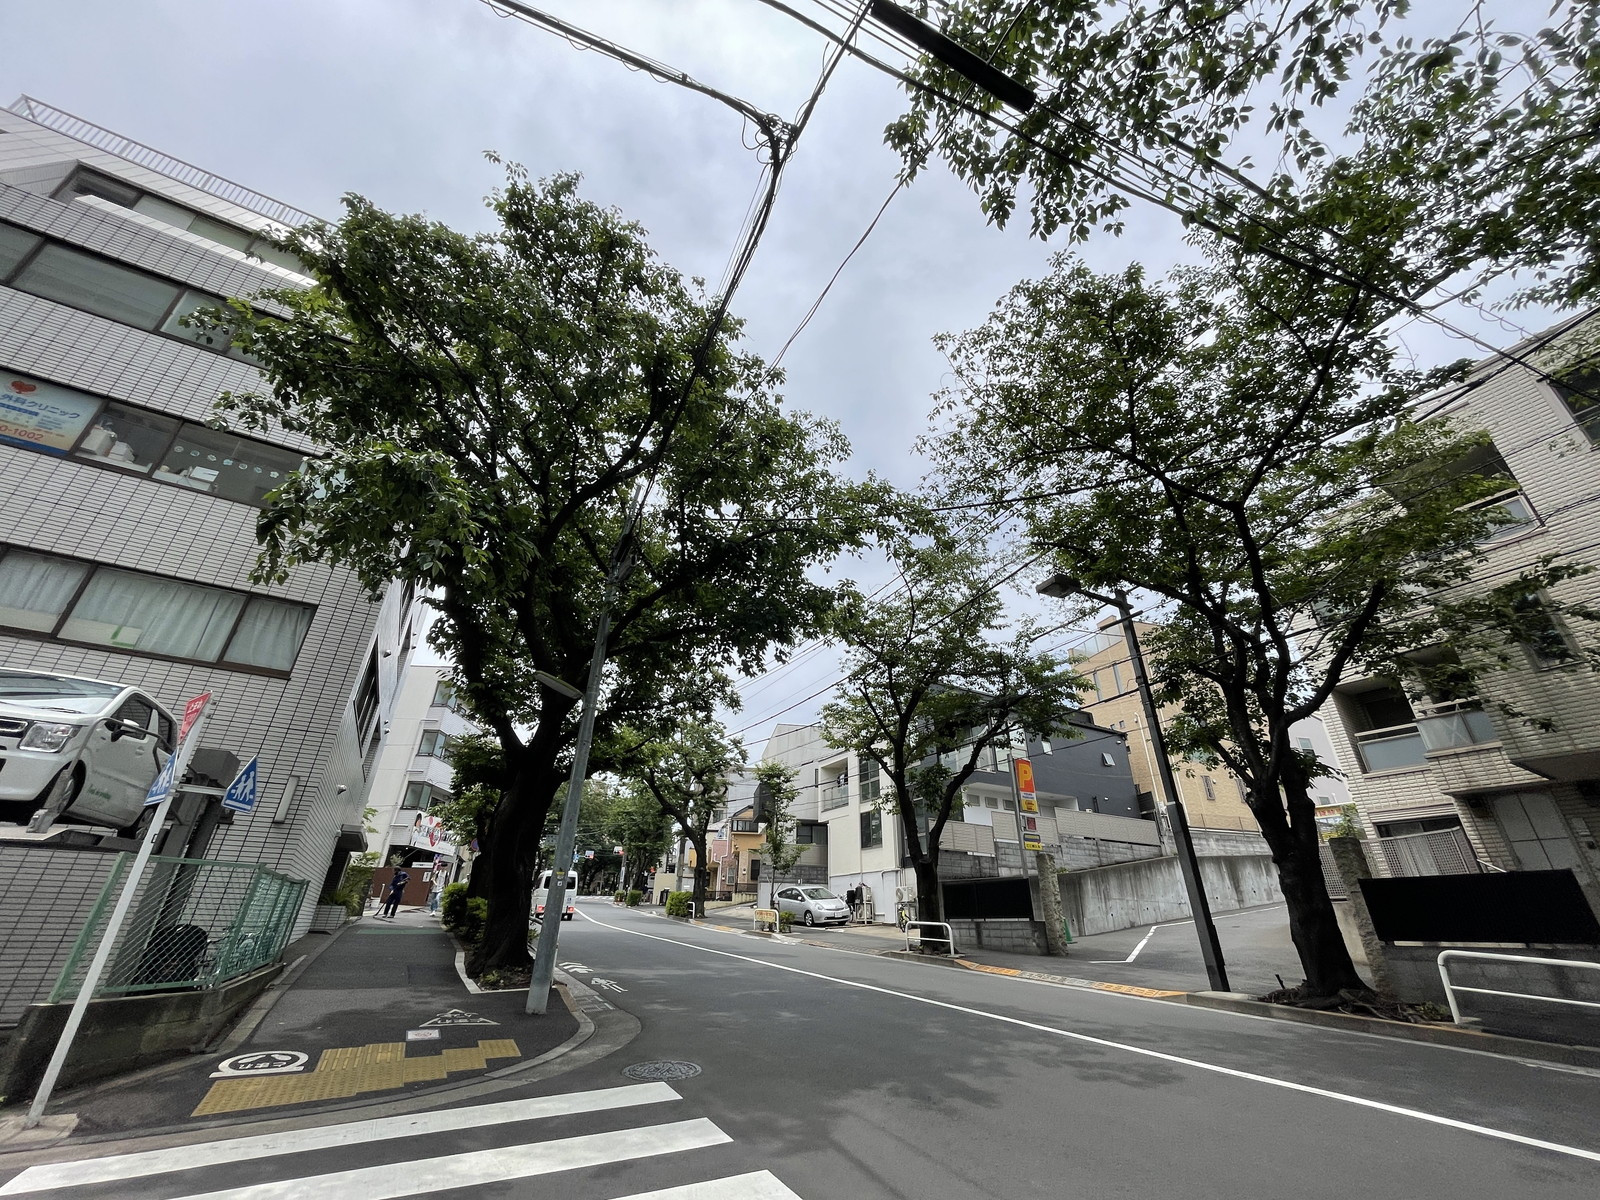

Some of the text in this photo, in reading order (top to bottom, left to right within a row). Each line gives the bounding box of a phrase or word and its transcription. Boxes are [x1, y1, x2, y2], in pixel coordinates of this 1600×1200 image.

[1, 393, 80, 419] 外科クリニック
[1019, 763, 1032, 788] P
